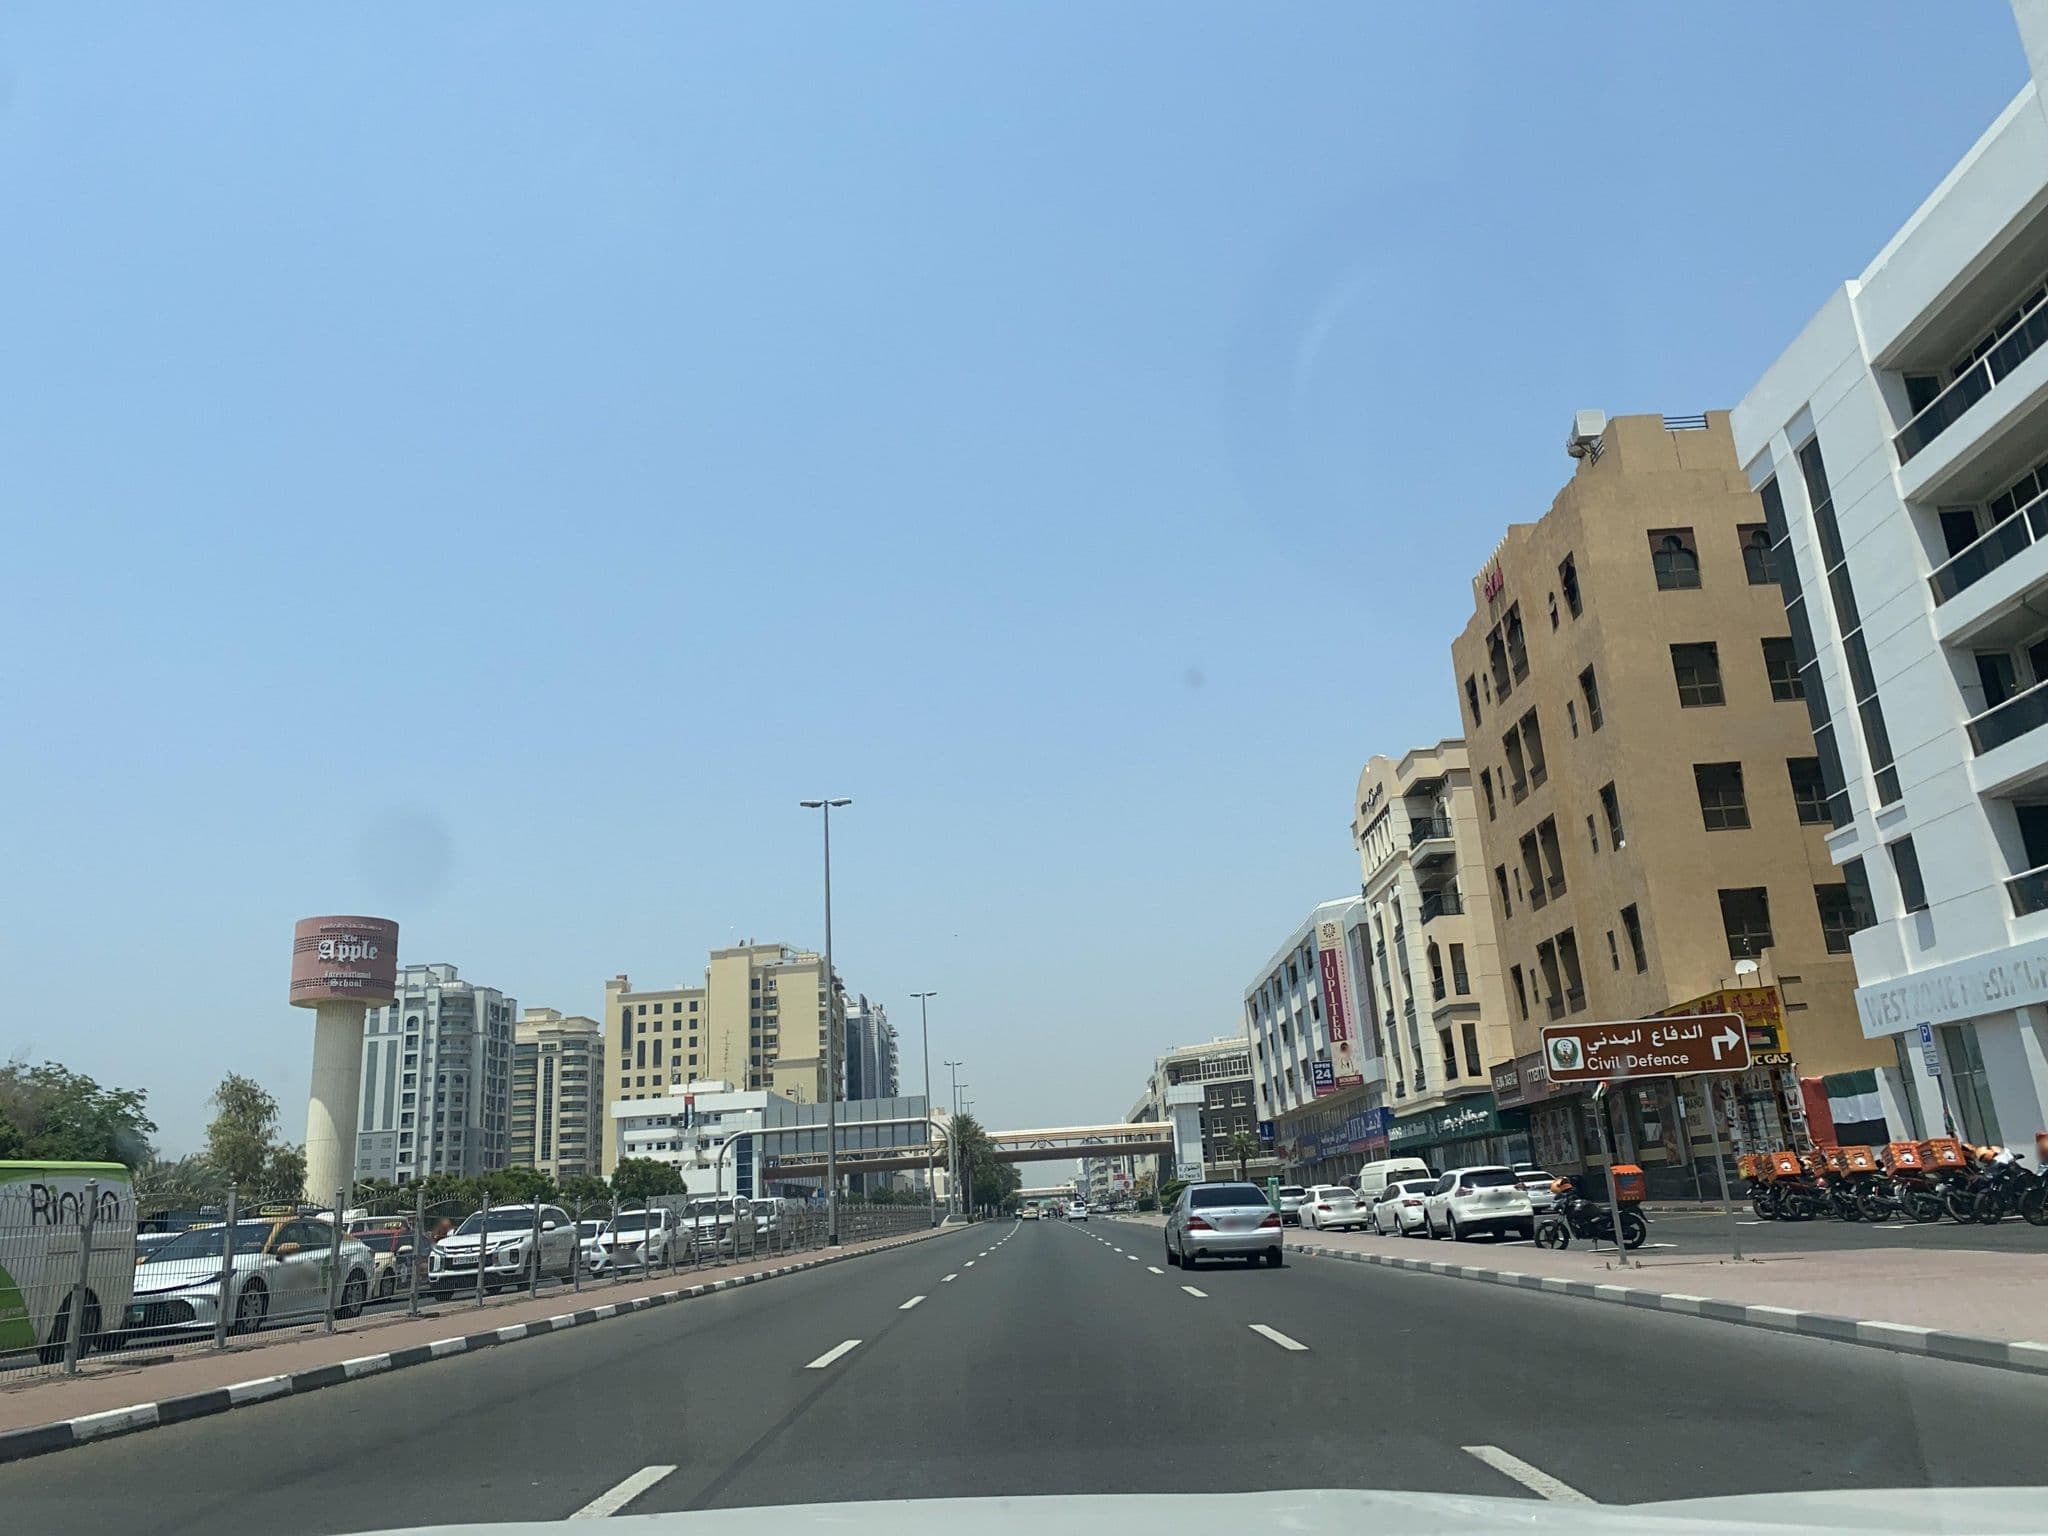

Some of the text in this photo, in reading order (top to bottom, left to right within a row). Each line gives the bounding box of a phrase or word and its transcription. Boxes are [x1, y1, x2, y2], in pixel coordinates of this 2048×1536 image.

[318, 939, 378, 962] Apple
[330, 979, 362, 987] School
[1324, 952, 1344, 1041] JUPITER
[1586, 1024, 1704, 1055] الدفاع المدني
[1586, 1053, 1690, 1071] Civil Defence
[1764, 1053, 1789, 1064] GAS
[1315, 1069, 1331, 1080] 24
